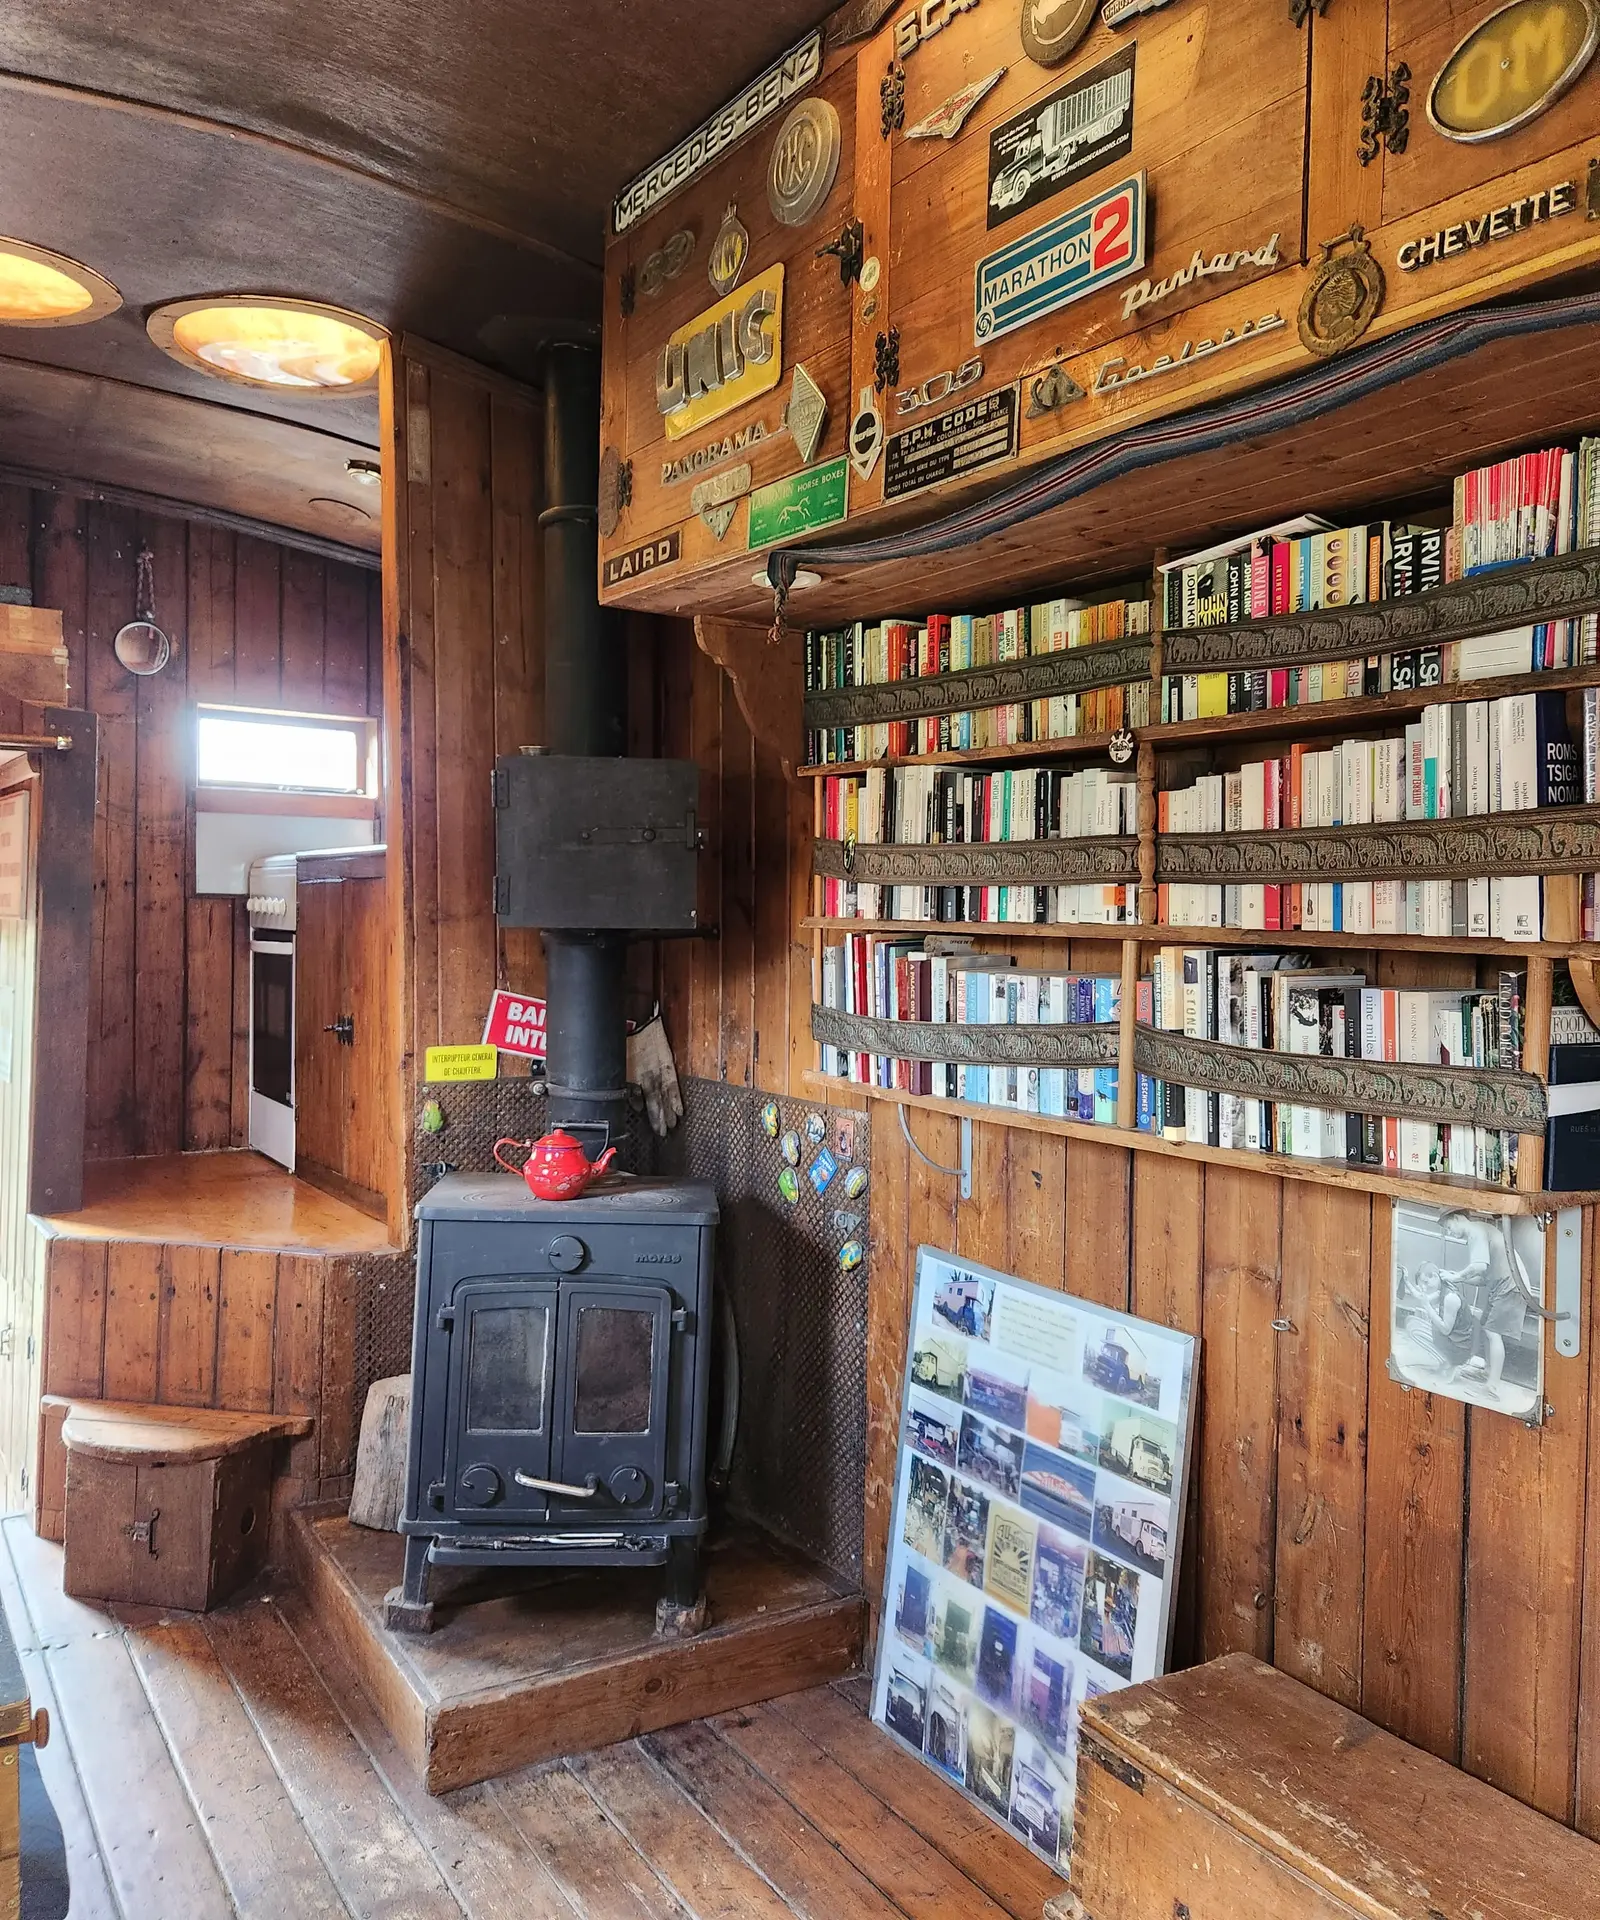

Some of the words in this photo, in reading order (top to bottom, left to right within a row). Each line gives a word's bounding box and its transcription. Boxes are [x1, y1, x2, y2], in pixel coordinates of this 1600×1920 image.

[894, 0, 980, 60] SCA
[1455, 7, 1567, 118] OM
[616, 40, 821, 229] MERCEDES-BENZ
[1051, 133, 1129, 181] WWW.PHOTOSDECAMIONS.COM
[1397, 180, 1576, 273] CHEVETTE
[984, 236, 1092, 306] MARATHON
[1092, 196, 1130, 269] 2
[1121, 233, 1282, 322] Panhard
[657, 289, 776, 415] UNIC
[896, 355, 983, 414] 305
[900, 423, 936, 449] S.P.M.
[942, 395, 1000, 431] CODER
[936, 425, 966, 442] COLOMBES
[991, 407, 1009, 418] FRANCE
[661, 420, 768, 486] PANORAMA
[888, 461, 899, 470] TYPE
[938, 453, 950, 465] TYPE
[797, 478, 819, 493] HORSE
[821, 468, 845, 485] BOXES
[902, 478, 917, 489] TOTAL
[609, 540, 671, 582] LAIRD
[1312, 549, 1320, 566] ACID
[1329, 542, 1341, 601] glue
[1371, 541, 1379, 600] Trainspotting
[1394, 534, 1413, 598] IRVIN
[1421, 528, 1440, 592] IRVIN
[1187, 574, 1195, 606] JOHN
[1230, 566, 1238, 596] JOHN
[1254, 560, 1266, 607] IRVINE
[1312, 570, 1320, 596] HOUSE
[1187, 609, 1195, 627] KIN
[1198, 593, 1227, 613] JOHN
[1199, 609, 1226, 627] KING
[940, 649, 949, 671] GIRL
[1393, 652, 1414, 690] LSH
[1420, 646, 1439, 687] LSH
[940, 716, 949, 744] SWEDEN
[1587, 713, 1596, 747] GYPSY
[1412, 741, 1421, 763] DEBOUT
[1547, 743, 1577, 761] ROMS
[1587, 753, 1595, 764] IN
[1547, 764, 1580, 782] TSIGA
[1521, 782, 1529, 808] ropéen
[1548, 786, 1581, 803] NOMA
[958, 979, 966, 1003] GYPSY
[1500, 982, 1512, 1020] FOOD
[911, 1001, 915, 1012] ON
[958, 1006, 966, 1020] BOY
[1186, 989, 1197, 1034] STONE
[1366, 995, 1375, 1020] nine
[1553, 1016, 1586, 1032] FOOD
[1366, 1024, 1377, 1055] miles
[432, 1053, 471, 1063] INTERRUPTEUR
[471, 1051, 494, 1061] GENERAL
[444, 1067, 451, 1076] DE
[452, 1067, 482, 1076] CHAUFFERIE
[1367, 1124, 1375, 1147] Hindle
